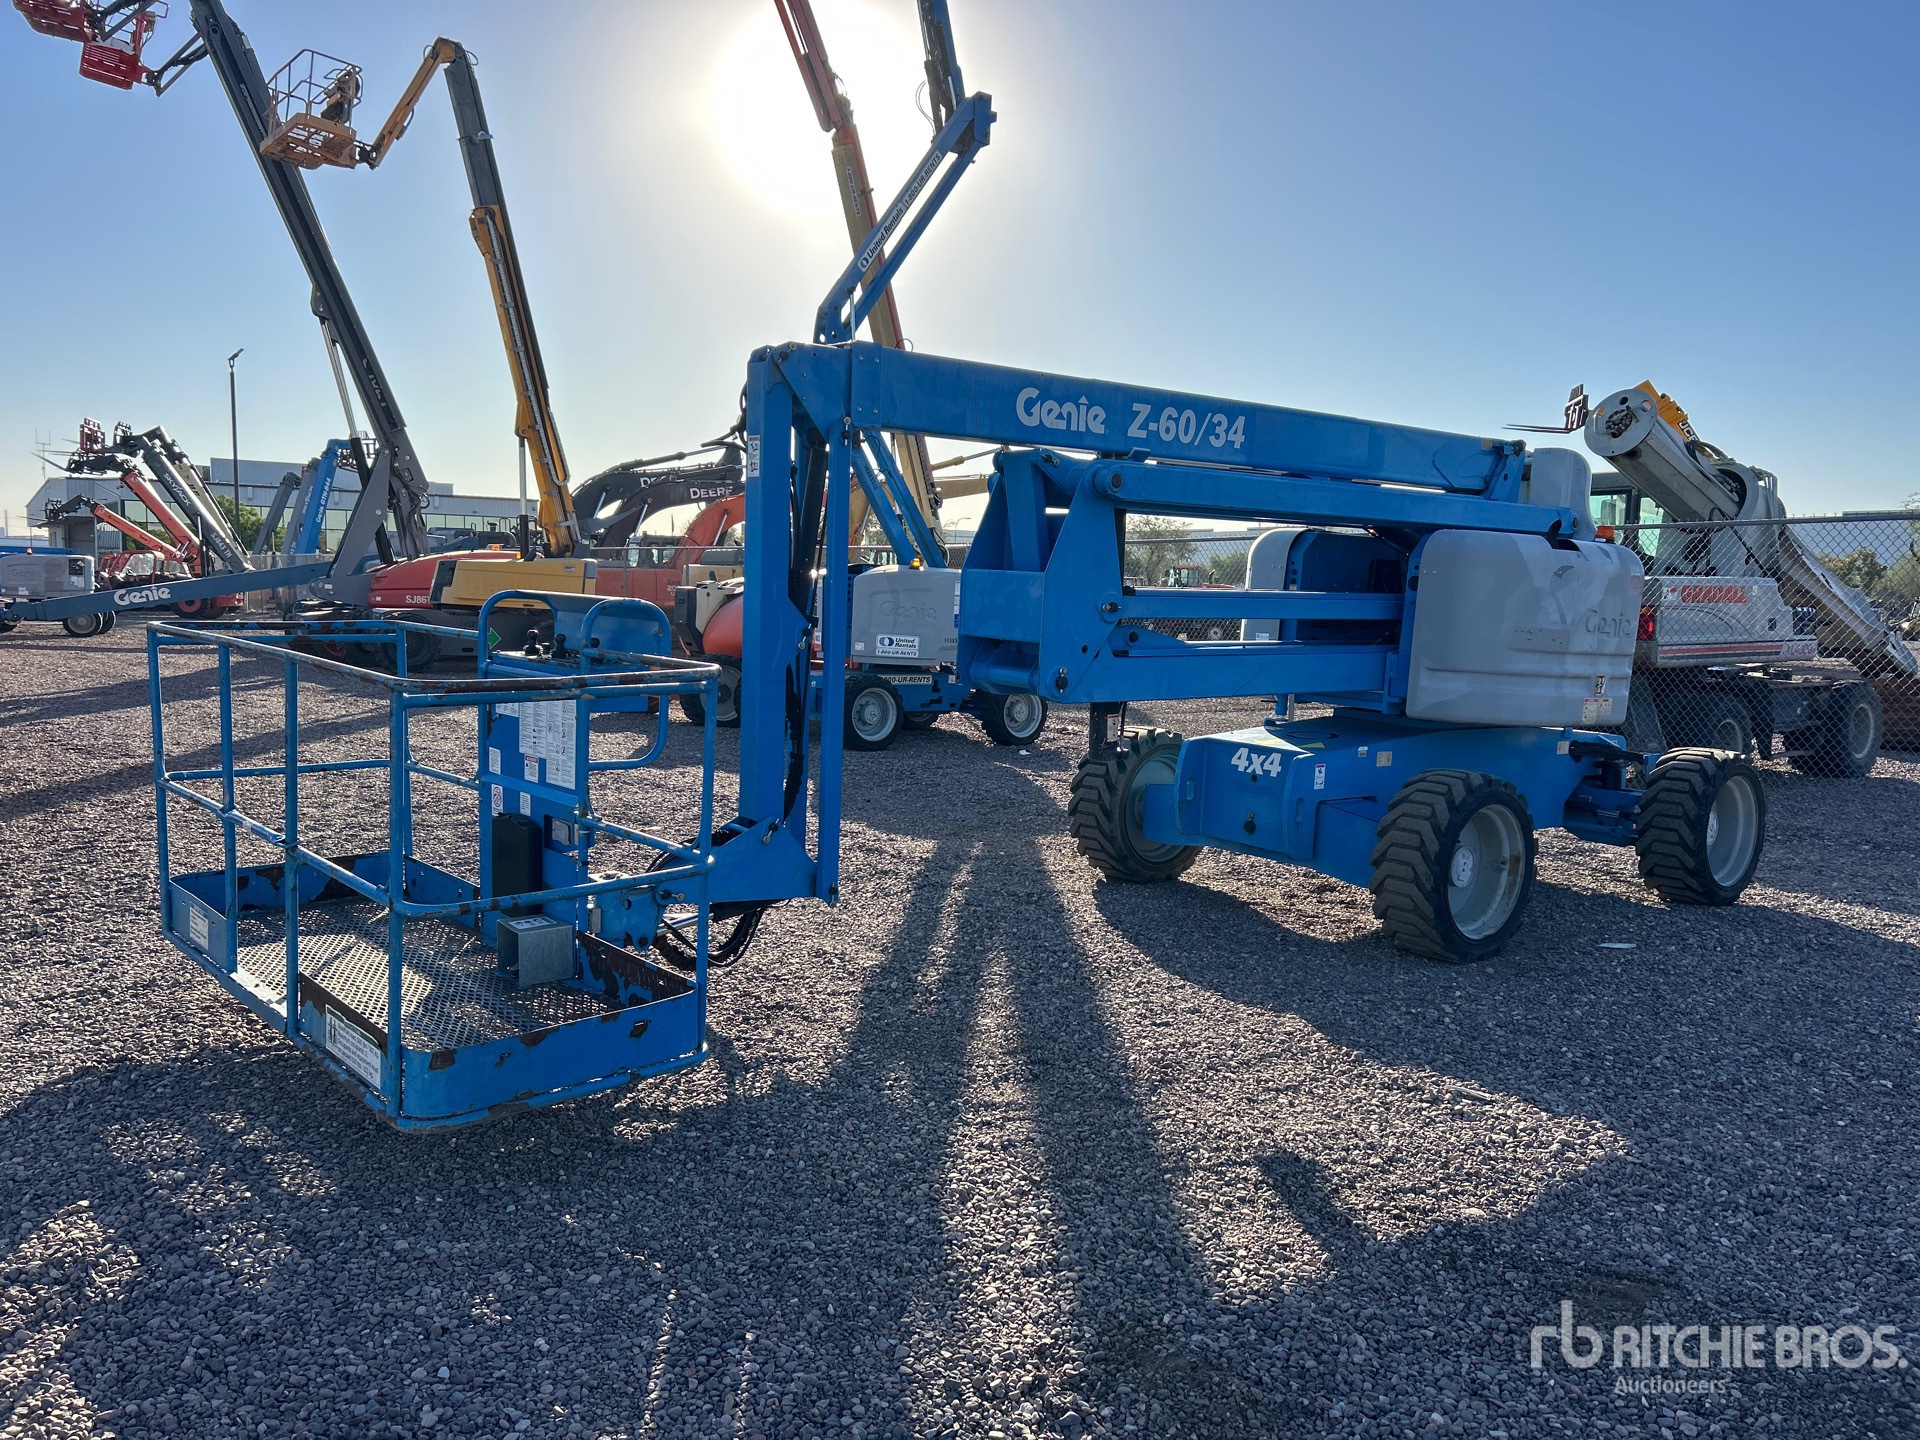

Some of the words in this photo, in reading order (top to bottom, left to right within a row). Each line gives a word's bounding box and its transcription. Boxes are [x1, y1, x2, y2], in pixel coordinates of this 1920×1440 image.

[904, 153, 941, 205] 1-800-UR-RENTS
[867, 232, 885, 258] United
[883, 207, 904, 235] Rentals
[1016, 387, 1106, 435] Genie
[1127, 402, 1246, 449] Z-60/34
[163, 472, 192, 507] SKYJACK
[223, 548, 233, 558] TH
[113, 585, 171, 606] Genie
[879, 601, 936, 620] Genie
[1585, 608, 1632, 638] Genie
[1231, 747, 1282, 777] 4x4
